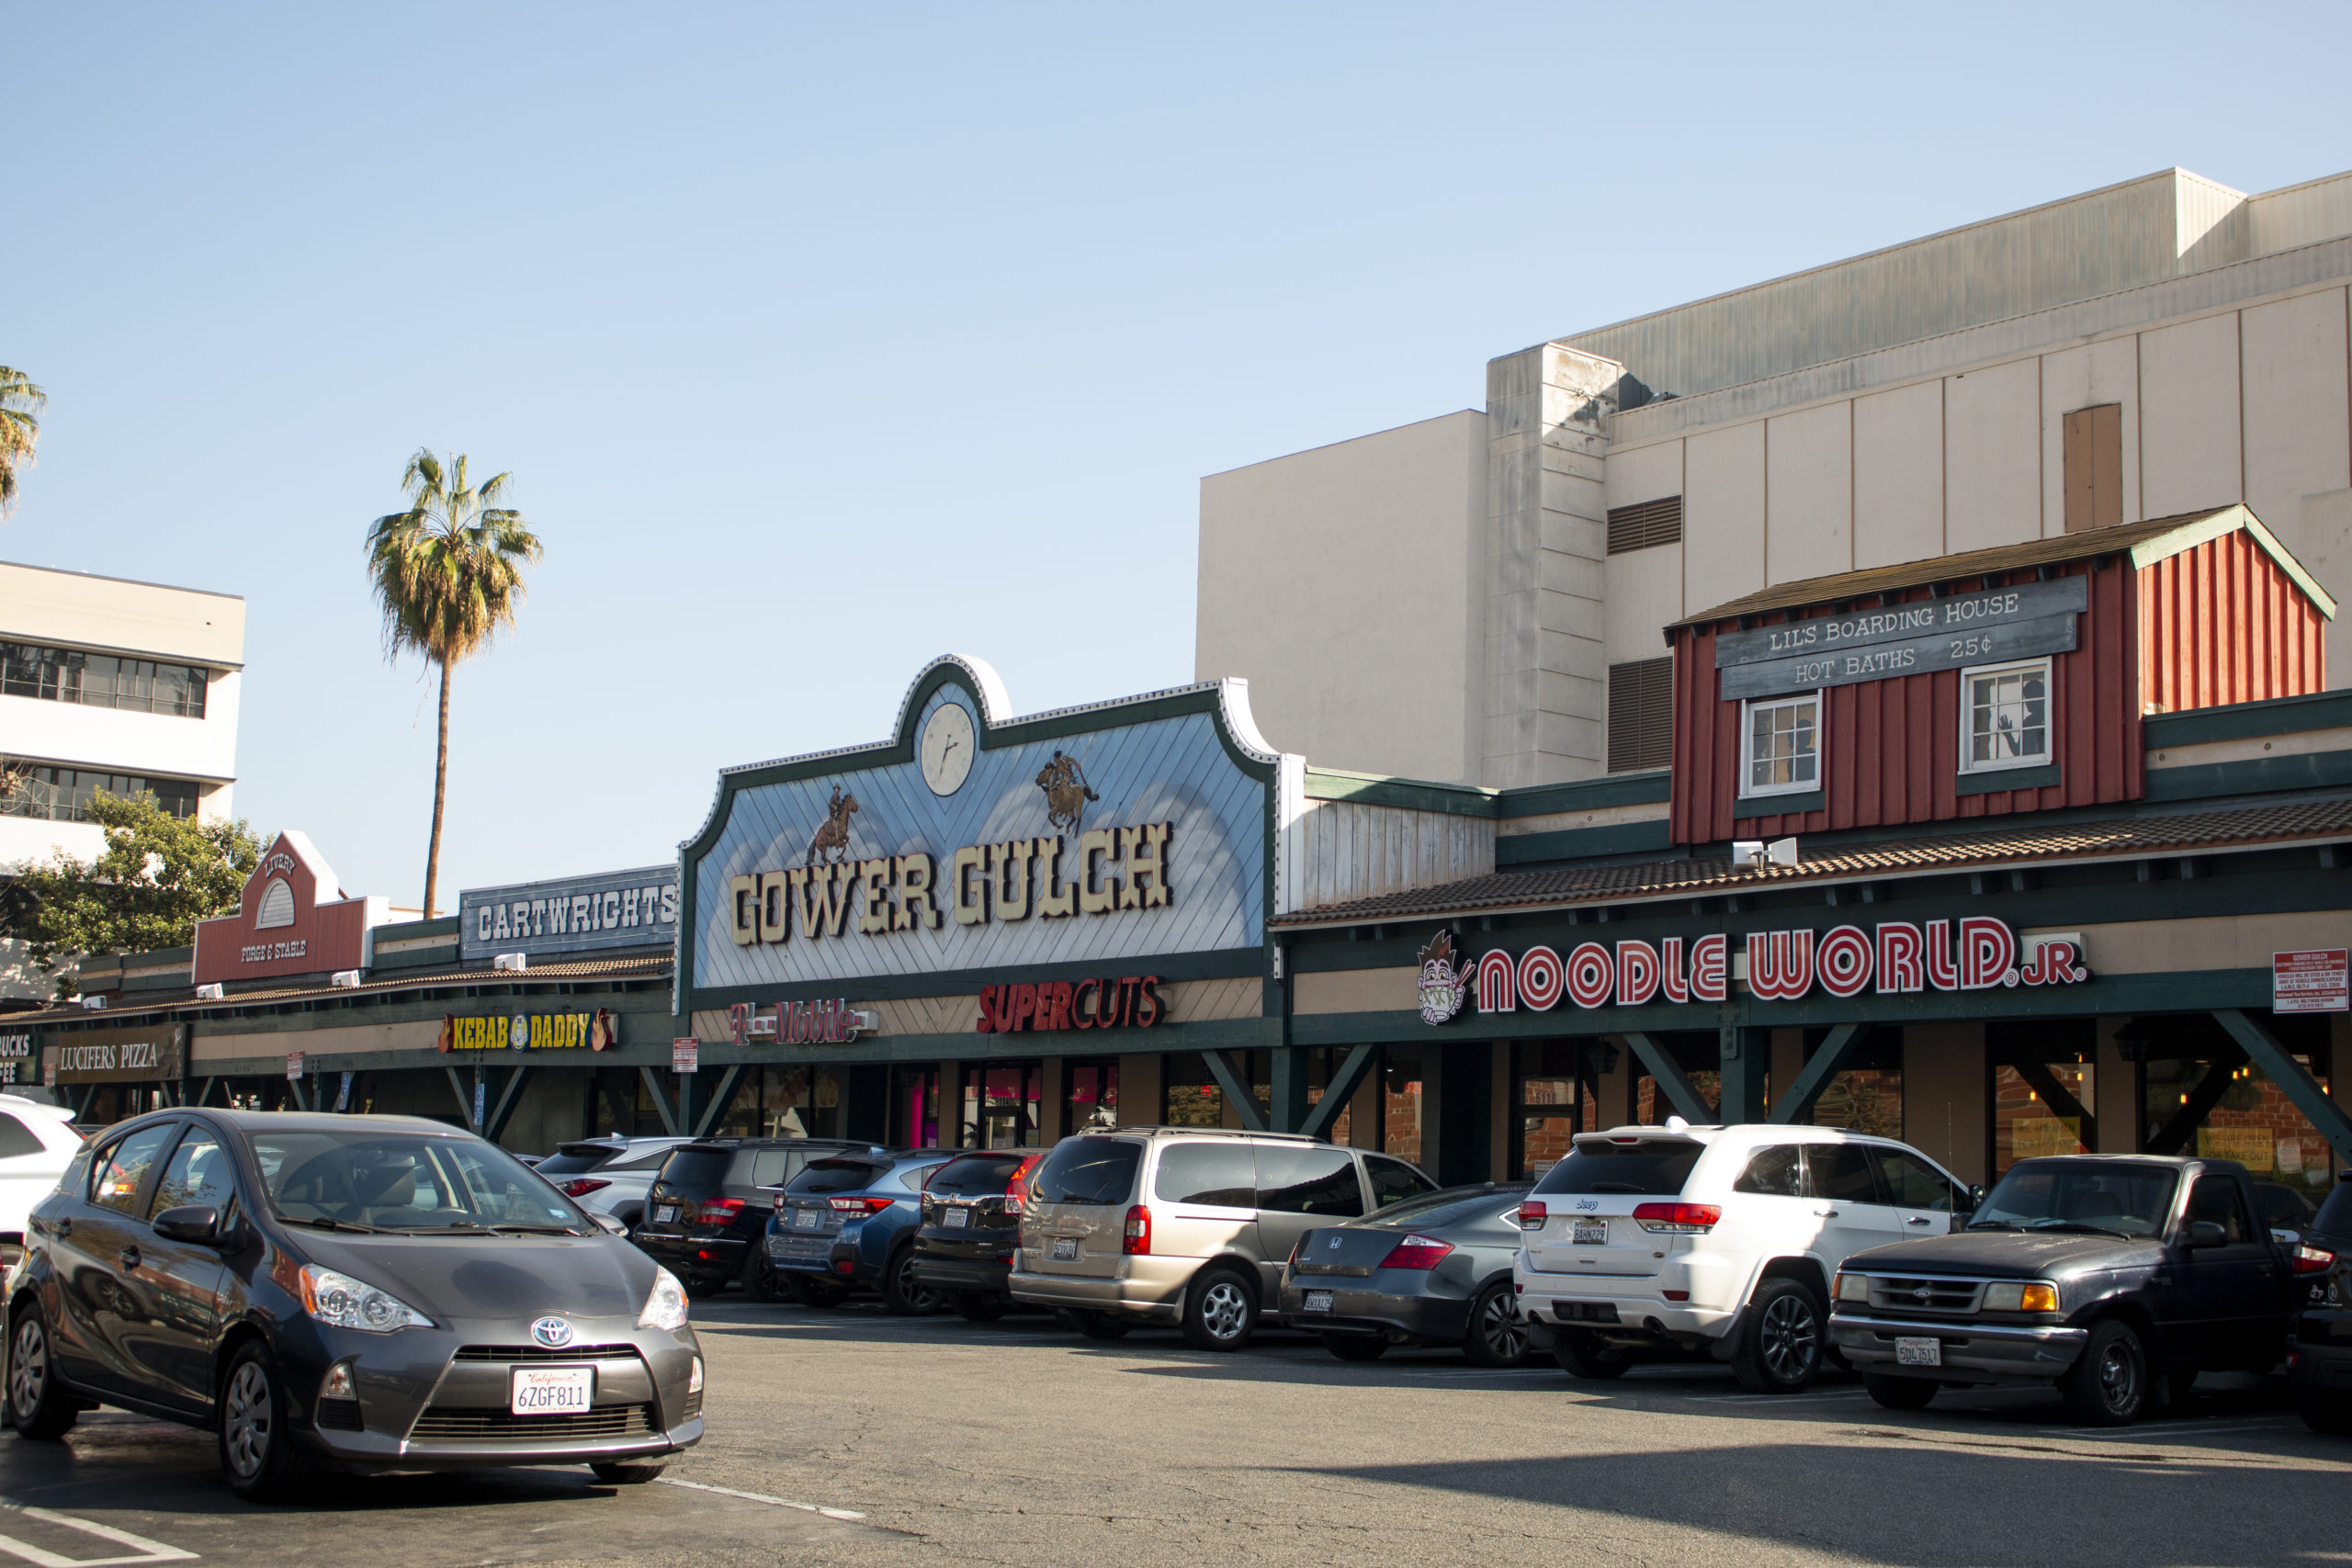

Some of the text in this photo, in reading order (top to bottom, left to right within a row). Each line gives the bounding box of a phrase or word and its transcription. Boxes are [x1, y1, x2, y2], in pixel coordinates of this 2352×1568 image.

[1770, 592, 2019, 651] LIL'S BOARDING HOUSE
[1795, 634, 1993, 683] HOT BATHS 25¢
[265, 852, 297, 878] LIVERY
[730, 821, 1174, 946] GOWER GULCH
[478, 884, 677, 942] CARTWRIGHTS
[242, 944, 266, 964] FORGE
[275, 940, 308, 960] STABLE
[1477, 933, 1727, 1013] NOODLE
[1747, 916, 2016, 1001] WORLD
[977, 975, 1159, 1033] SUPERCUTS
[453, 1013, 591, 1050] KEBAB DADDY
[0, 1034, 30, 1057] UCKS
[60, 1043, 159, 1070] LUCIFERS PIZZA
[1535, 1093, 1556, 1104] 6118
[1576, 1199, 1599, 1211] Jeep
[1574, 1228, 1605, 1240] 8AHN229
[531, 1372, 573, 1386] California
[518, 1386, 584, 1407] 6ZGF811
